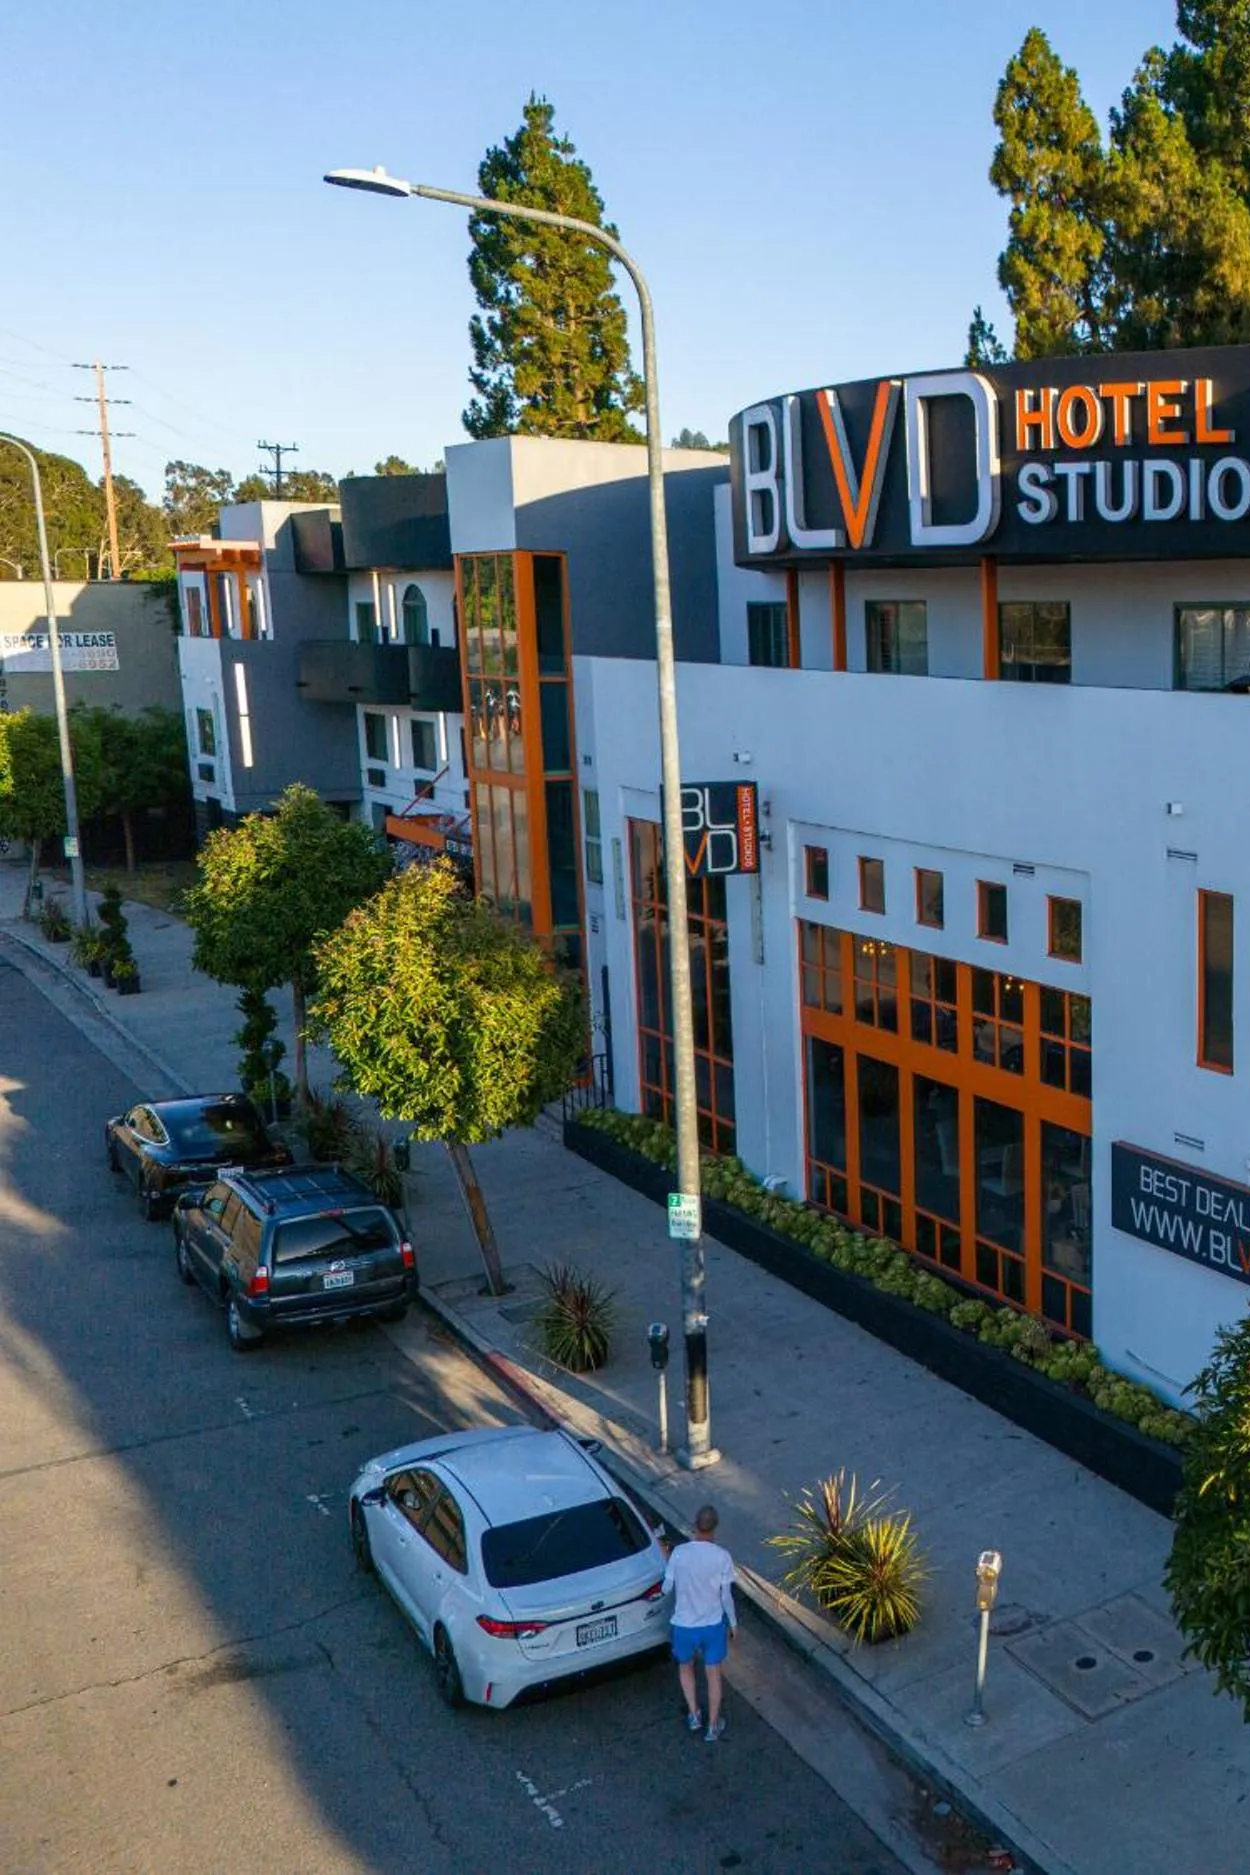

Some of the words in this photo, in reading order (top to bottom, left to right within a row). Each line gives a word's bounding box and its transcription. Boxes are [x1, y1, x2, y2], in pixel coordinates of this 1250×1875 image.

[1015, 377, 1236, 451] HOTEL
[742, 372, 1001, 554] BLVD
[4, 634, 44, 649] SPACE
[76, 634, 114, 648] LEASE
[1140, 1164, 1191, 1207] BEST
